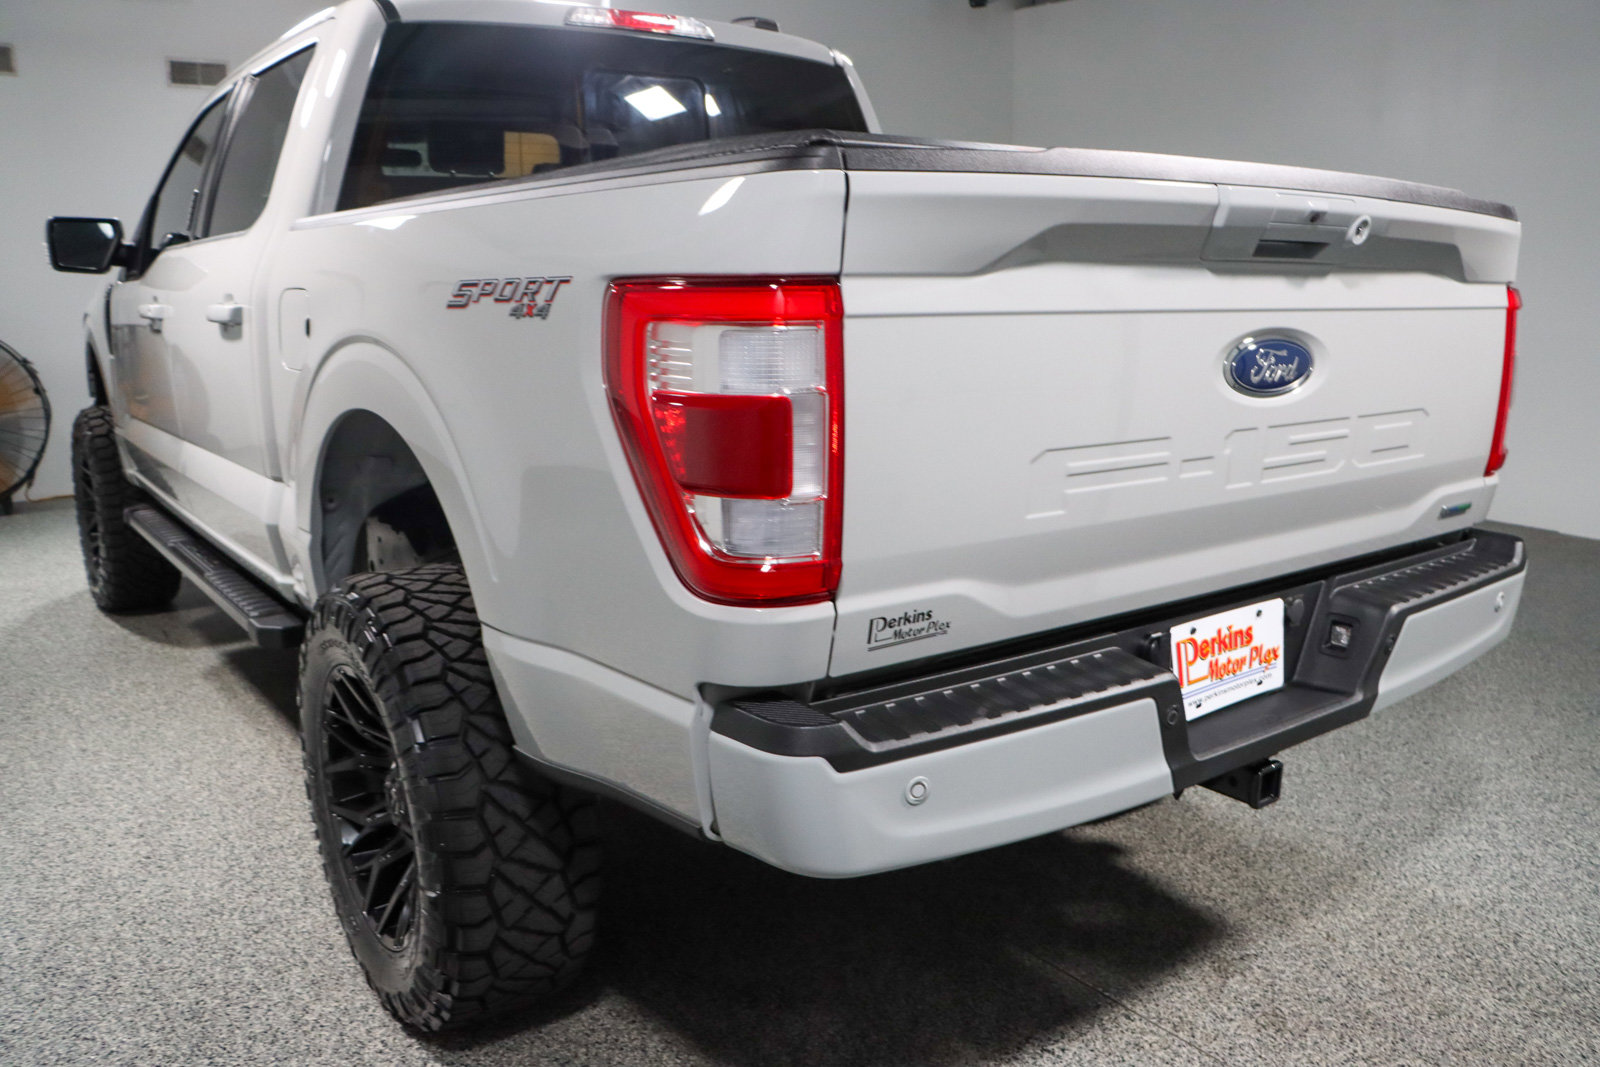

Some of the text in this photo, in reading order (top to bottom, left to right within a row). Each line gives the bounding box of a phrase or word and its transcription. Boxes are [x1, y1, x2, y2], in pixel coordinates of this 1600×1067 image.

[446, 276, 574, 309] SPORT
[1250, 348, 1299, 384] Ford
[1025, 408, 1429, 518] F-150
[867, 609, 933, 645] Perkins
[1176, 624, 1254, 688] Perkins
[1208, 643, 1280, 682] Motor Plex
